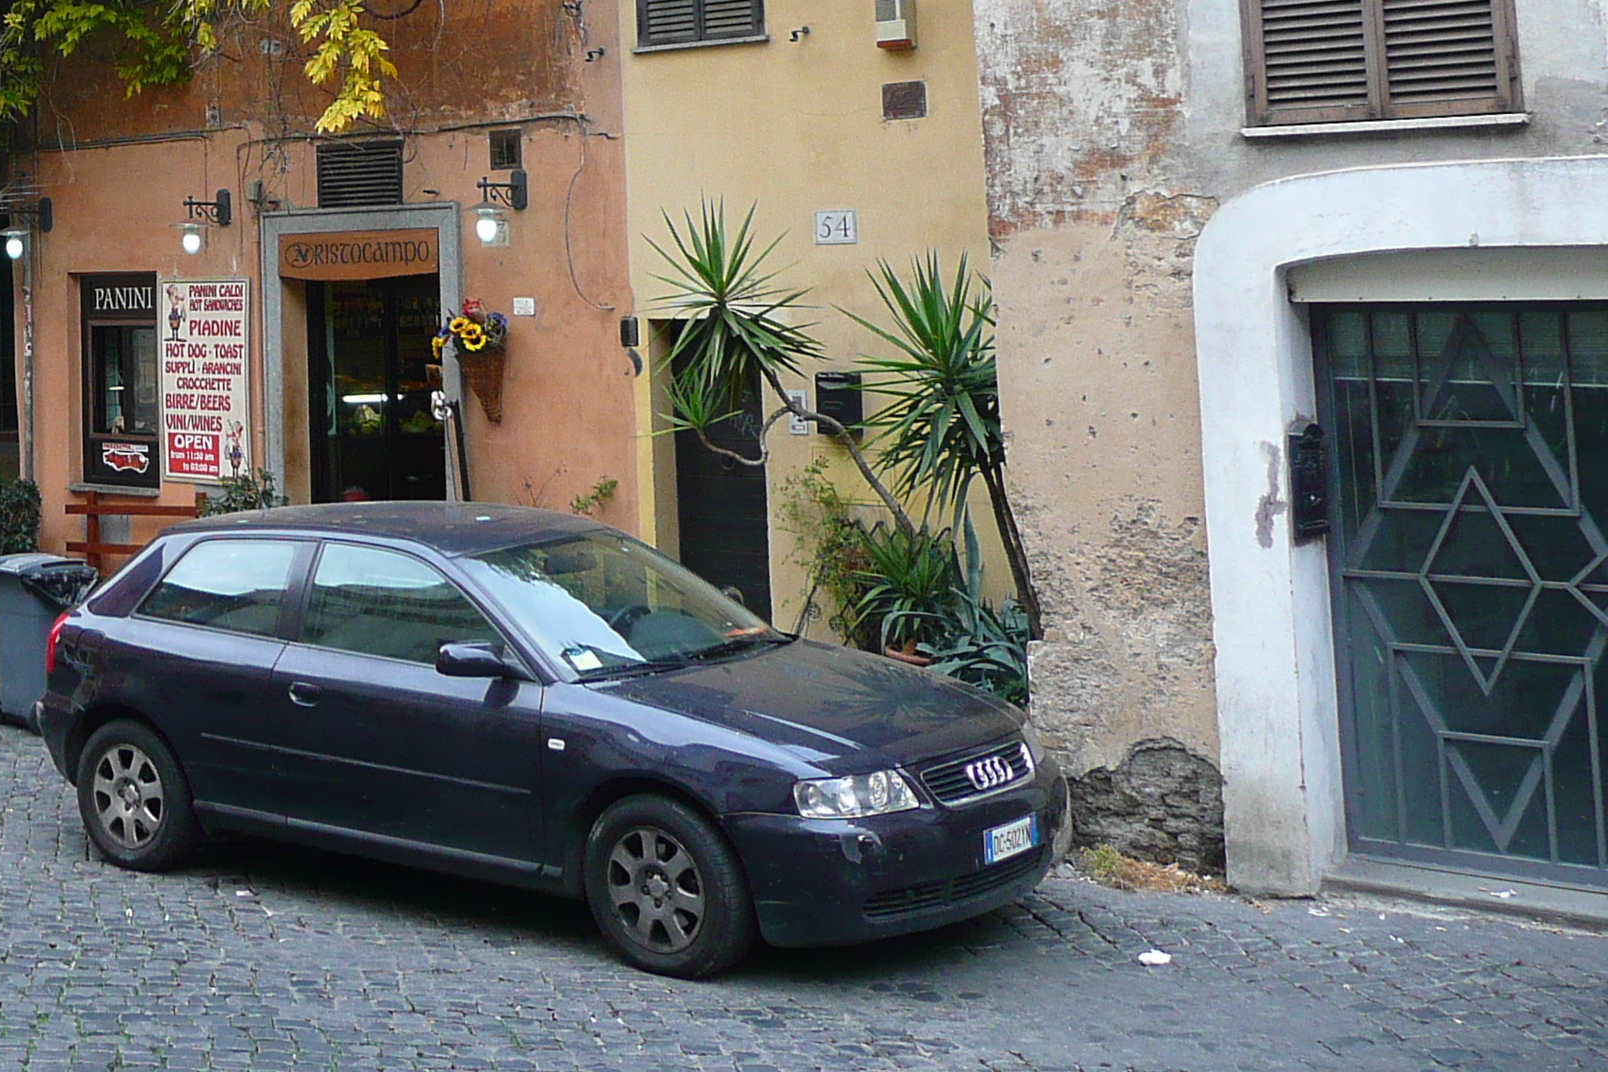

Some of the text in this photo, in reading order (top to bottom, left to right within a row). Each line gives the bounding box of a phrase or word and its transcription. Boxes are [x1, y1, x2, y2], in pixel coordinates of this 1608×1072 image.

[819, 215, 851, 239] 54
[94, 287, 152, 310] PANINI
[189, 284, 243, 298] PANINI CALDI
[189, 299, 243, 311] HOT SANDWICHES
[189, 319, 241, 337] PIADINE
[166, 343, 243, 359] HOT DOG TOAST
[202, 361, 242, 375] ARANCINI
[176, 377, 231, 391] CROCCHETTE
[166, 393, 231, 411] BIRRE/BEERS
[165, 413, 223, 432] VINI/WINES
[174, 434, 212, 450] OPEN
